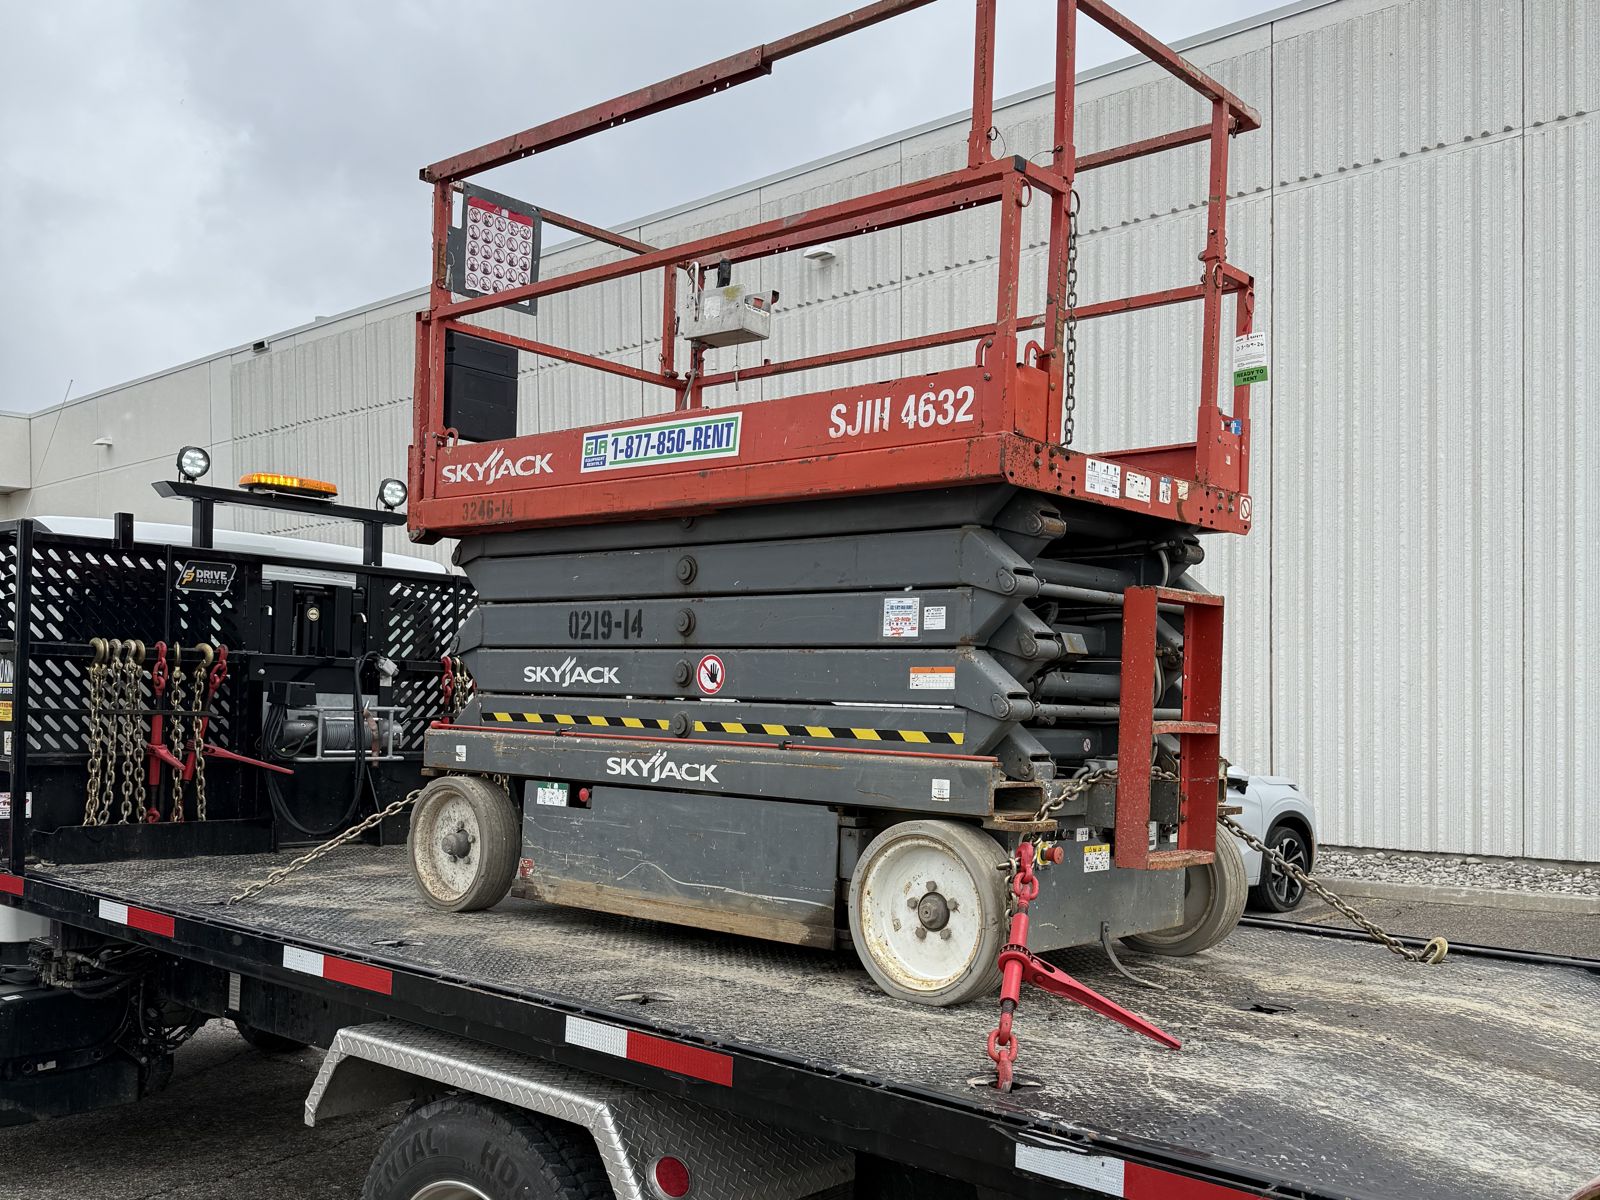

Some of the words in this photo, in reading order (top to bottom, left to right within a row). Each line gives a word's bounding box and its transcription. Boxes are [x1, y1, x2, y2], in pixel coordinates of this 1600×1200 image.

[1236, 370, 1255, 378] READY
[901, 385, 975, 430] 4632
[585, 434, 608, 456] GTA
[611, 421, 735, 461] 1-877-850-RENT
[442, 448, 553, 485] SKYJACK
[462, 499, 513, 521] 3246-14
[196, 569, 227, 580] DRIVE
[568, 609, 643, 640] 0219-14
[523, 656, 621, 687] SKYJACK
[606, 749, 719, 783] SKYJACK
